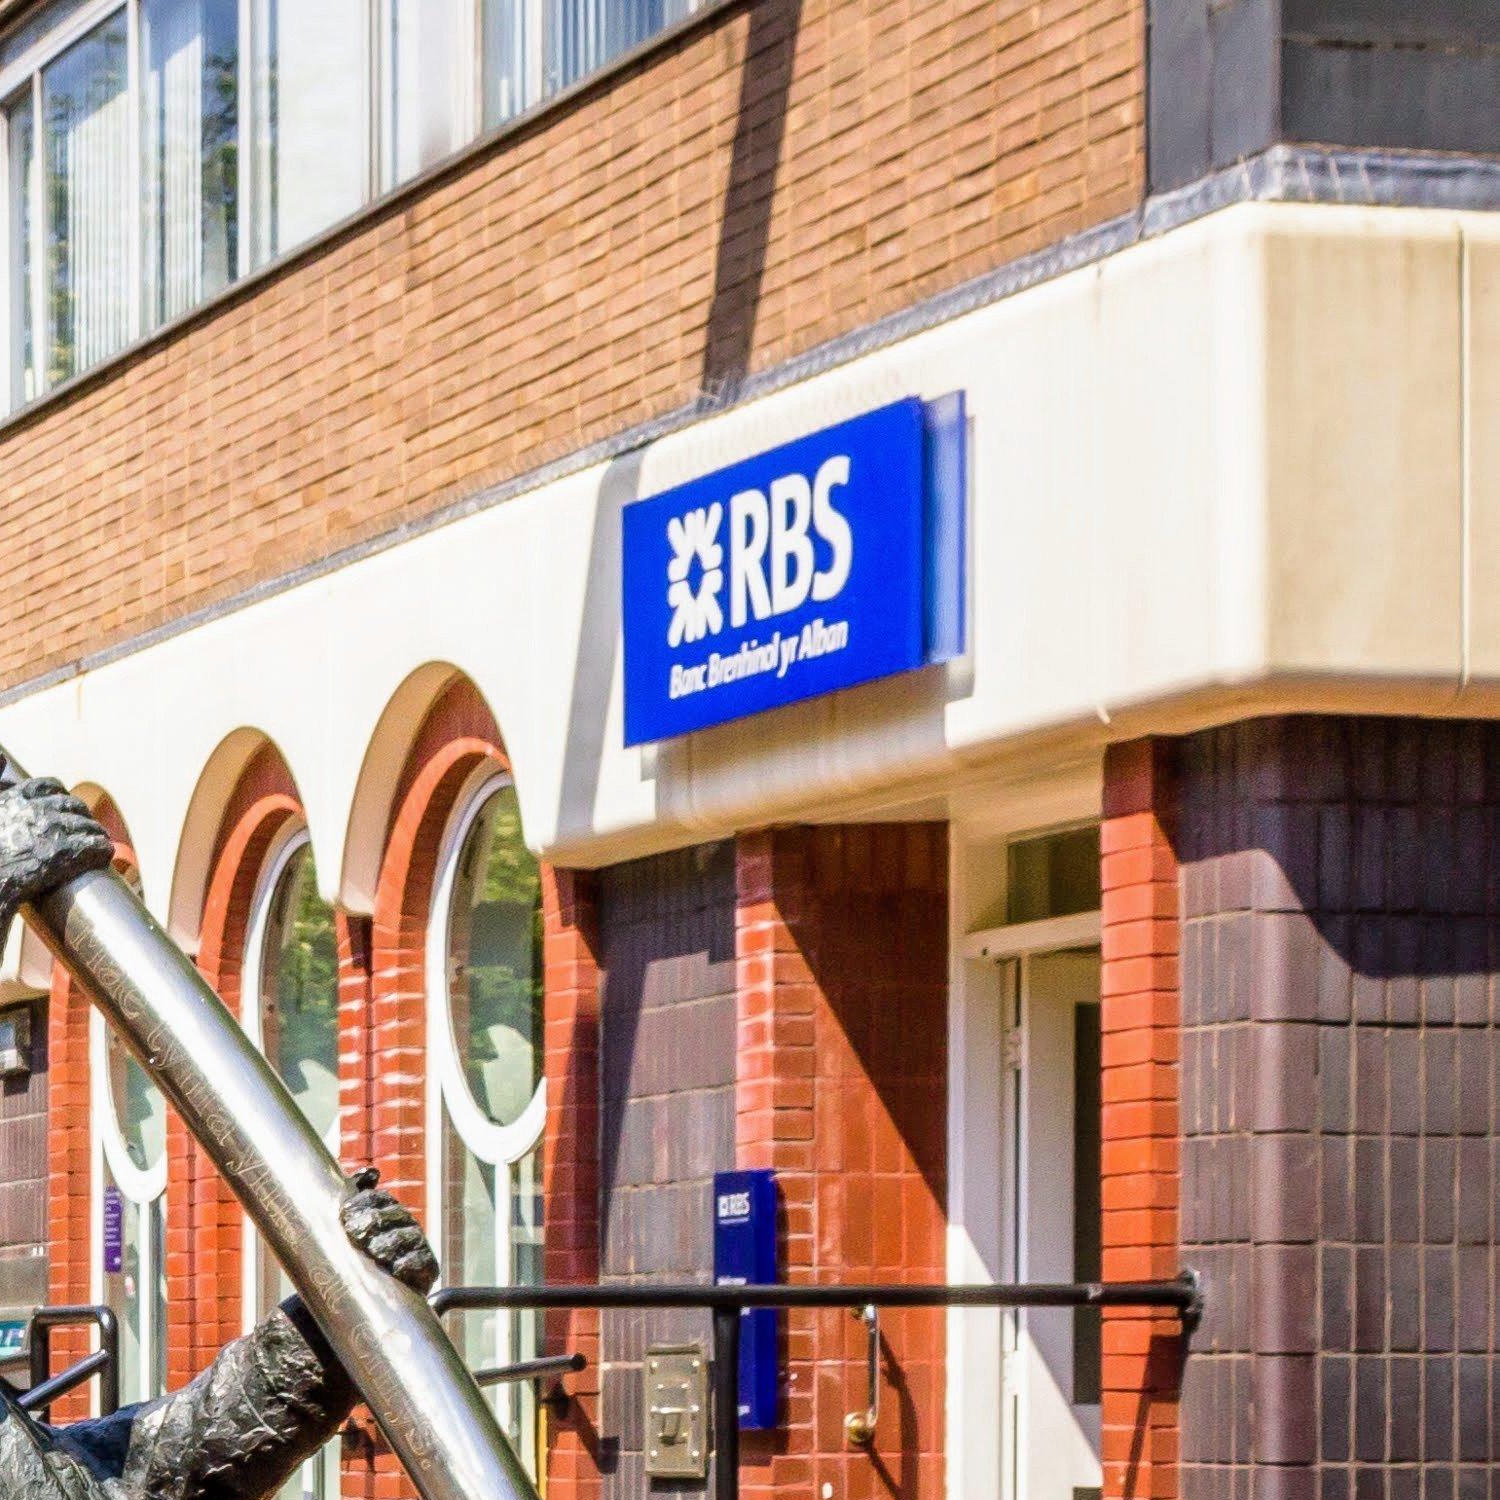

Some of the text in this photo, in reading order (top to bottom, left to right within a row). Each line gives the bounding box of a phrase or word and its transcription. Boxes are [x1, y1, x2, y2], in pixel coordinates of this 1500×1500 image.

[729, 455, 852, 629] RBS
[668, 617, 849, 700] Banc Brenhinol yr Alban
